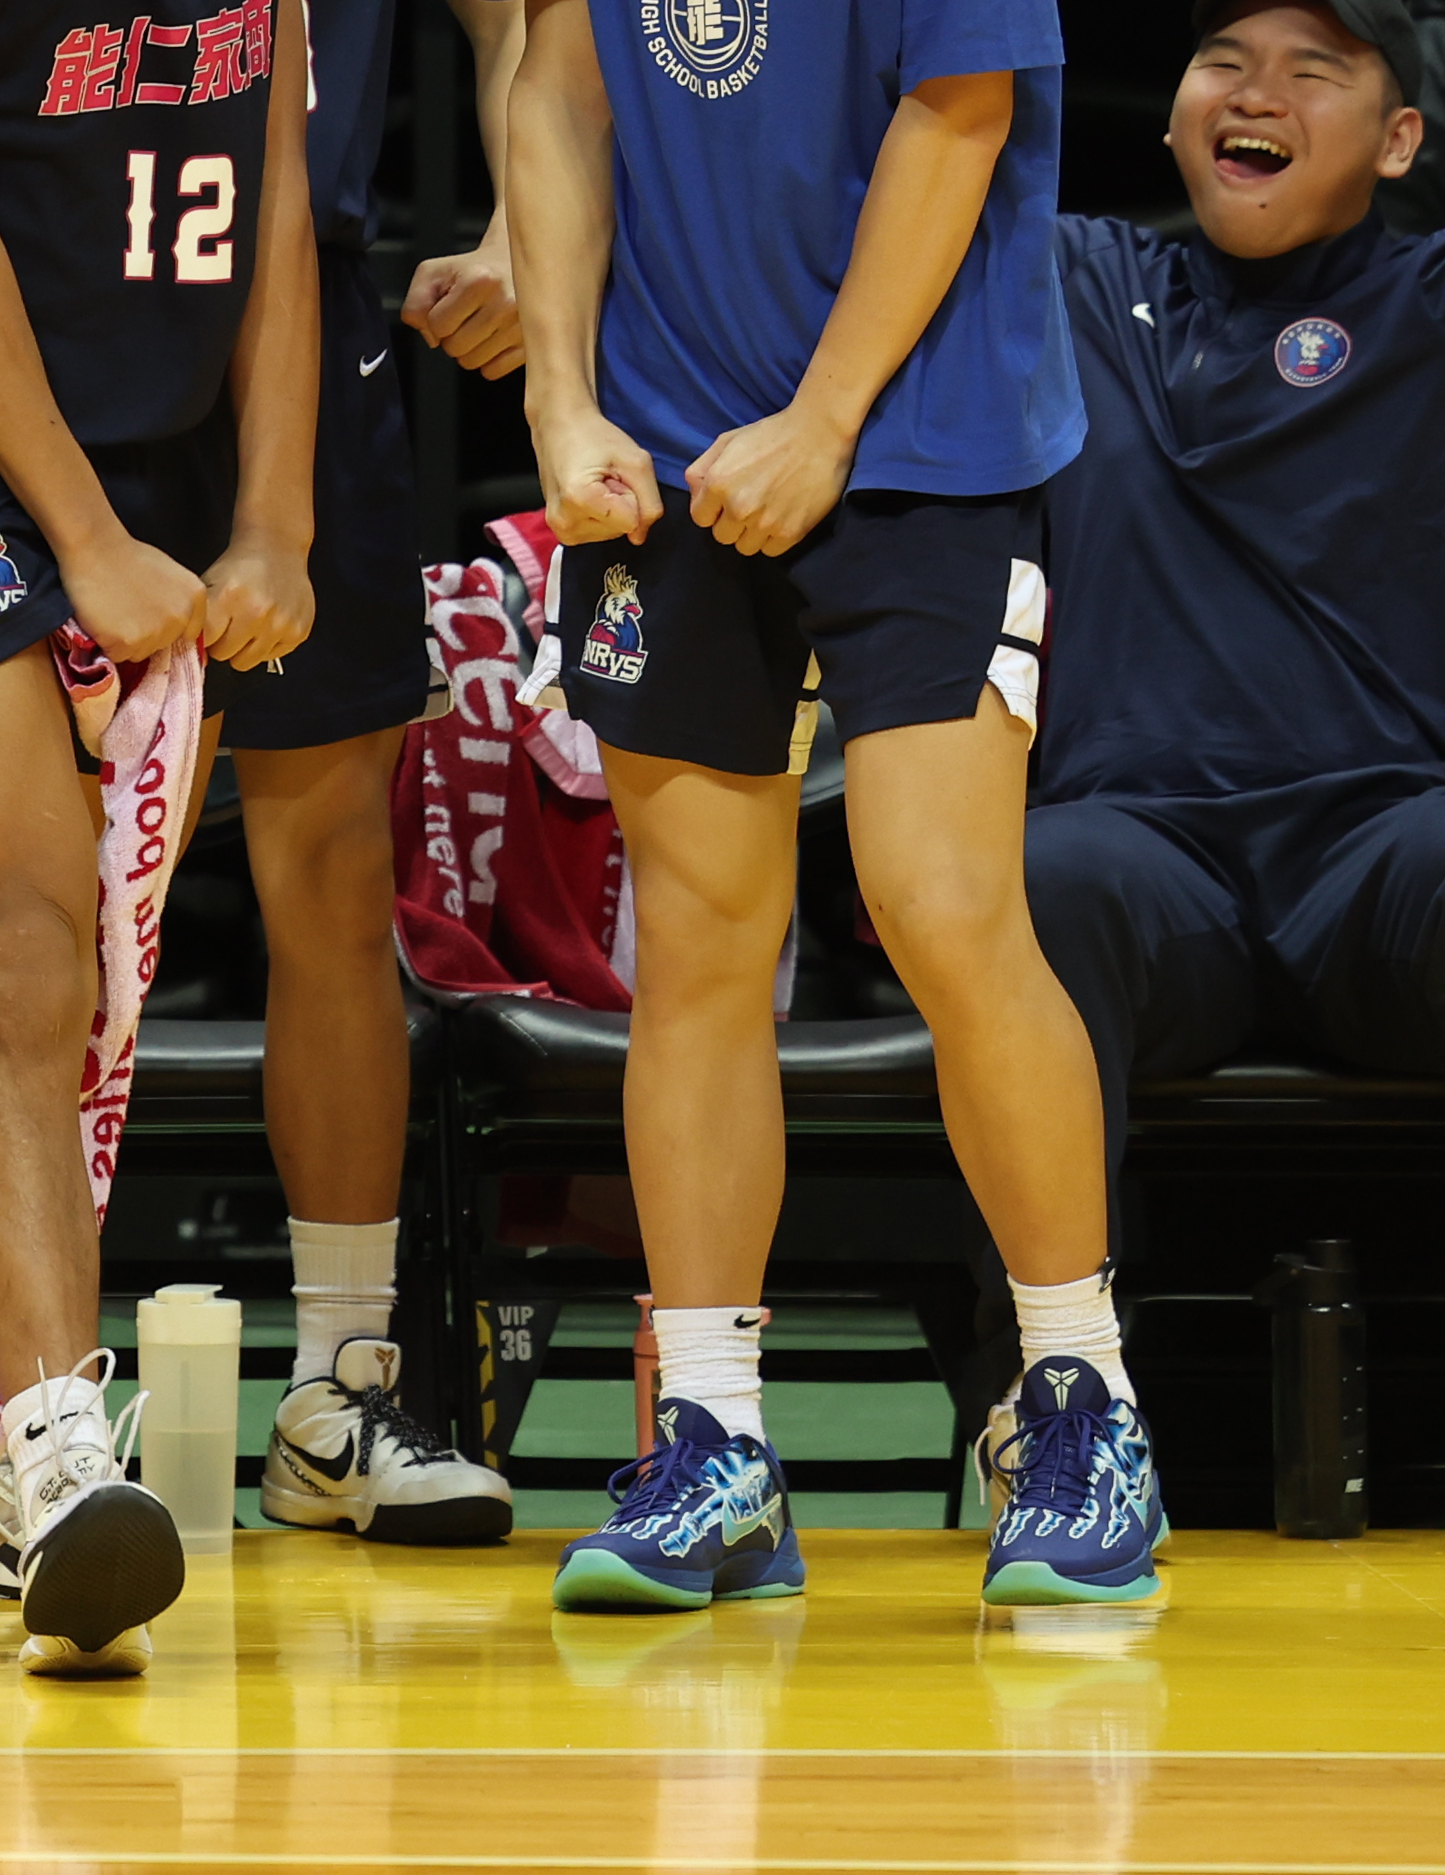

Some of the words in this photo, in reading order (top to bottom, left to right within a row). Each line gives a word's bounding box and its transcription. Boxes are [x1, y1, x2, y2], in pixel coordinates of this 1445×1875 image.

[648, 36, 706, 99] SCHOOL
[123, 149, 237, 285] 12
[498, 1306, 534, 1326] VIP
[500, 1329, 531, 1361] 36
